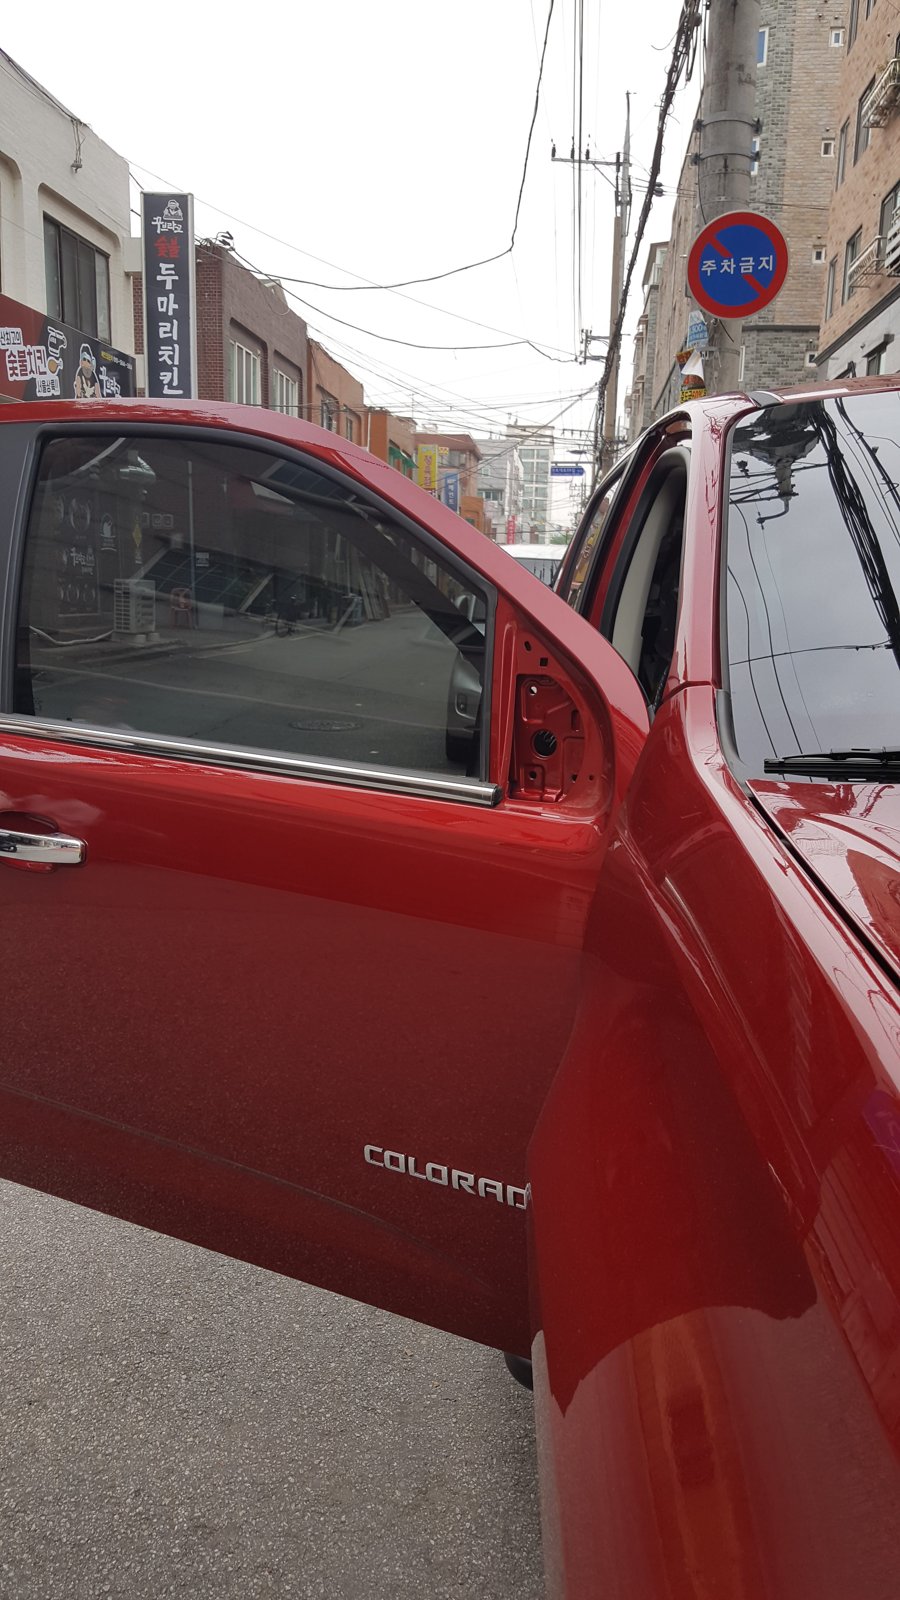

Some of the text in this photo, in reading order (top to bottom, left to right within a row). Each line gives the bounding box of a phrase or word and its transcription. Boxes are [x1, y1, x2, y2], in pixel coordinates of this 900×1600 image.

[701, 254, 774, 276] 주차금지
[156, 262, 184, 395] 두마리치킨
[7, 346, 47, 377] 숯불치킨
